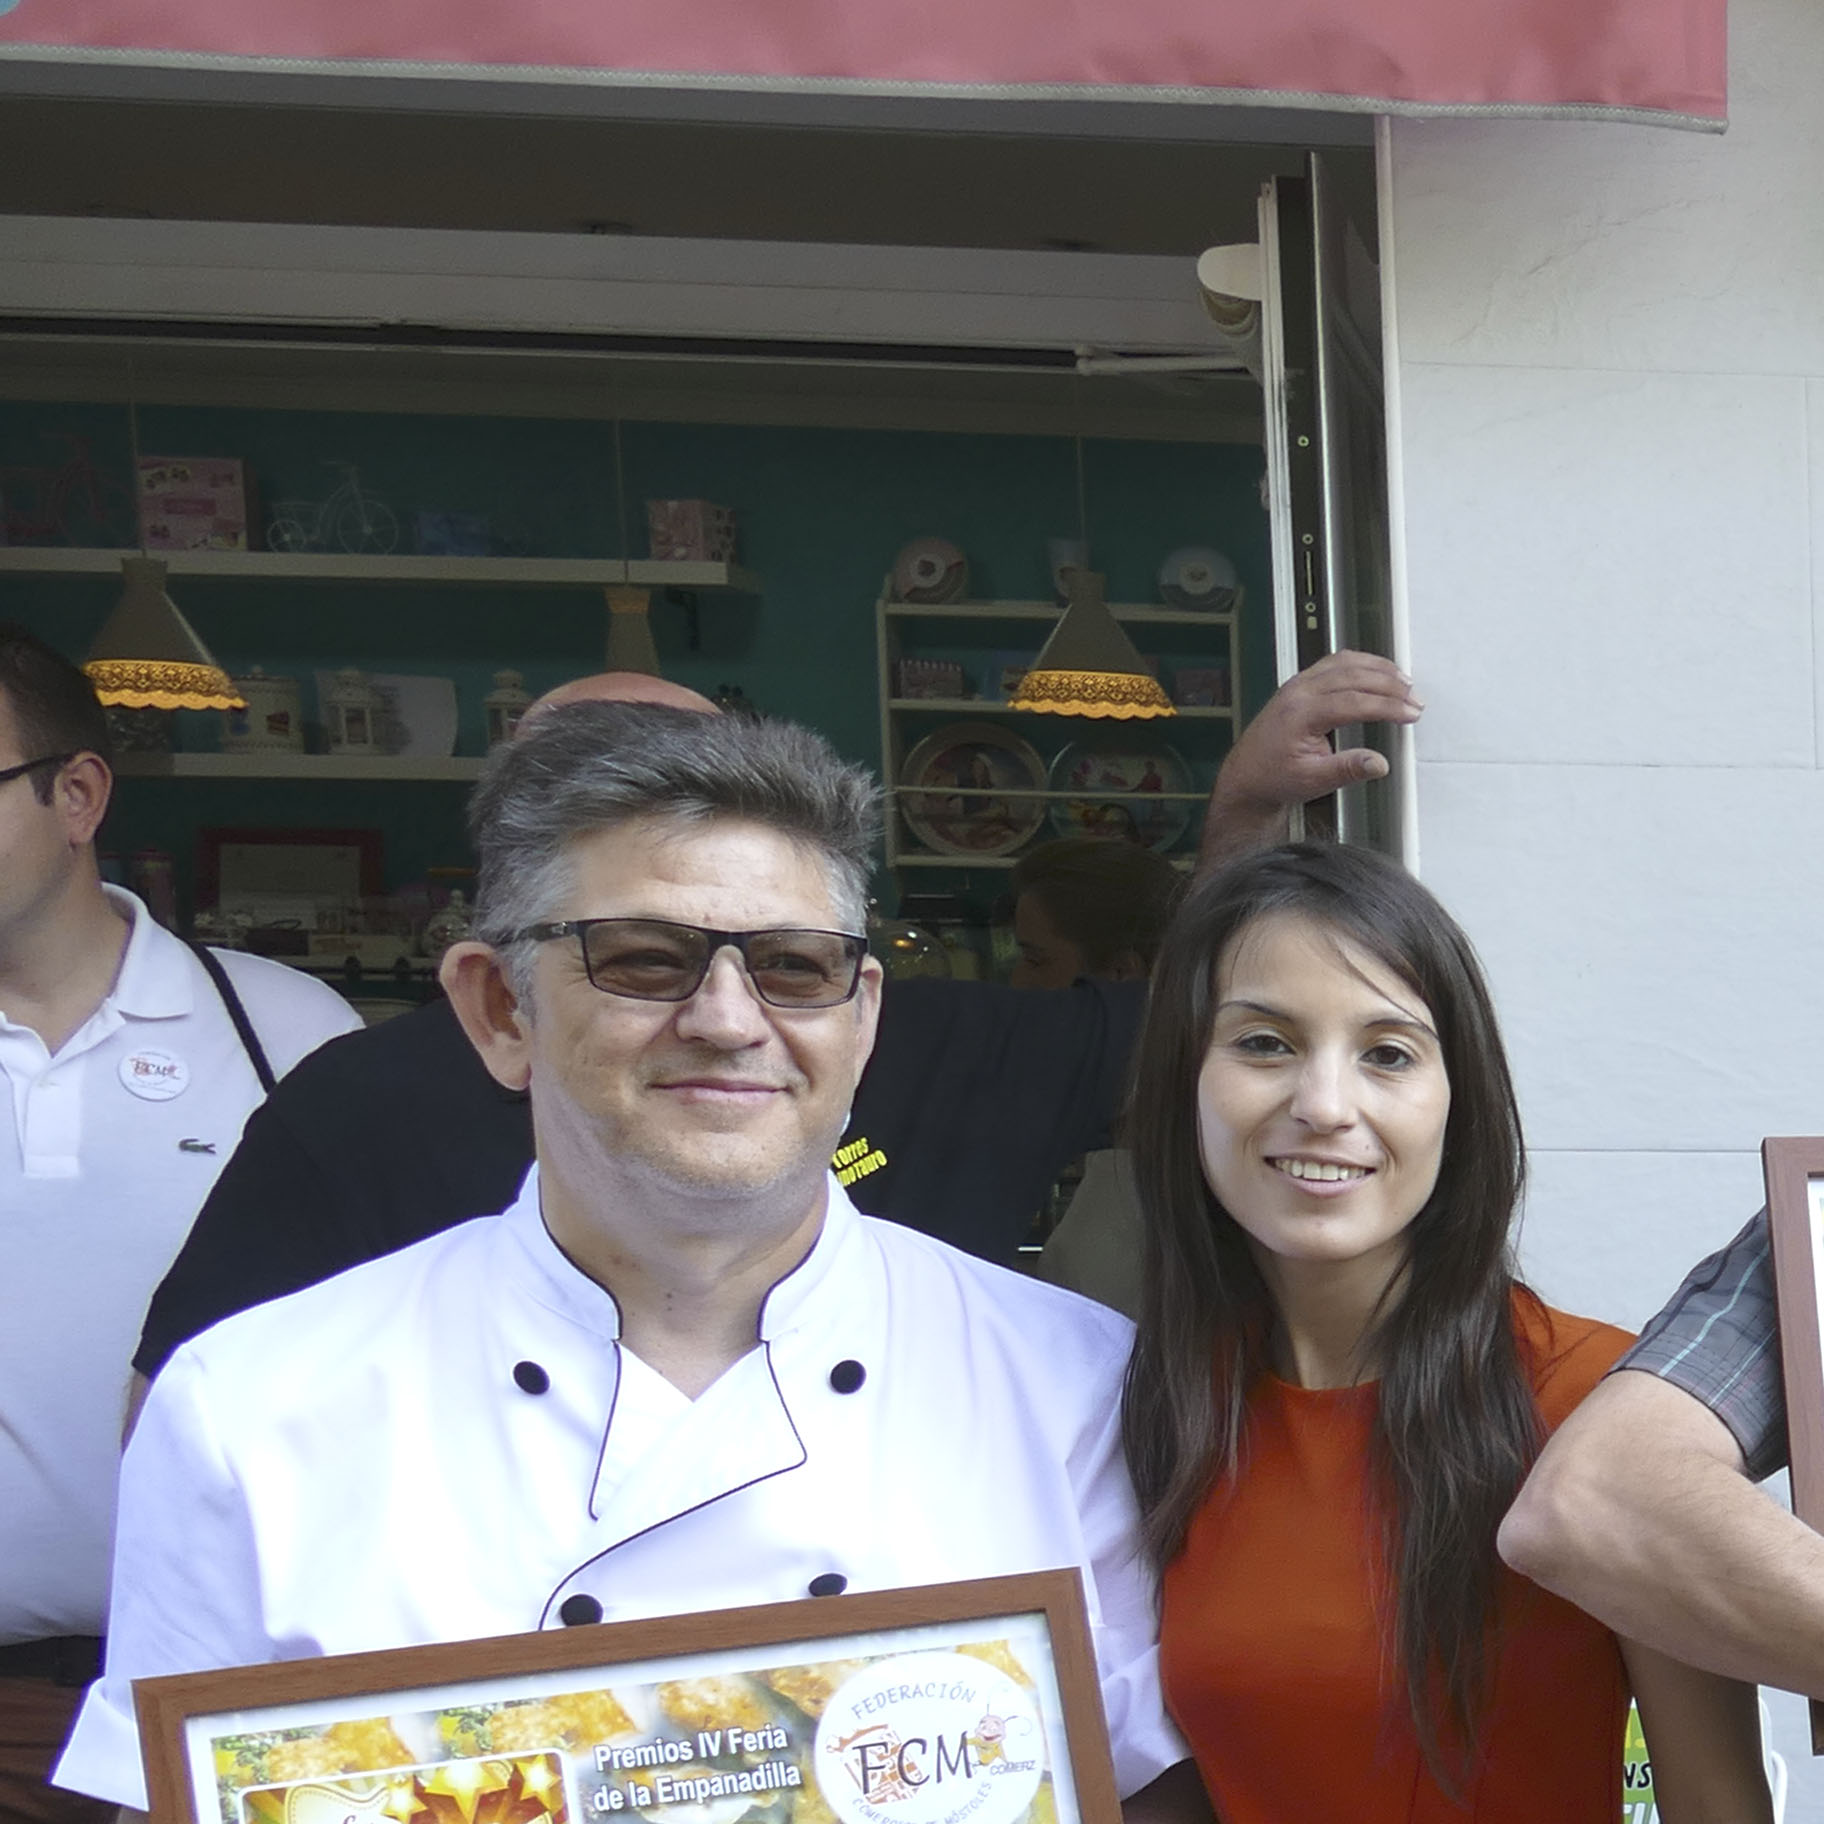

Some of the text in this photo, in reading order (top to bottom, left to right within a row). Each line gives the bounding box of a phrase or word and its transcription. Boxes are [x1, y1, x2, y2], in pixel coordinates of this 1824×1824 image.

[594, 1724, 788, 1772] Premios IV Feria
[851, 1730, 975, 1794] FCM
[593, 1764, 801, 1813] de la Empanadilla
